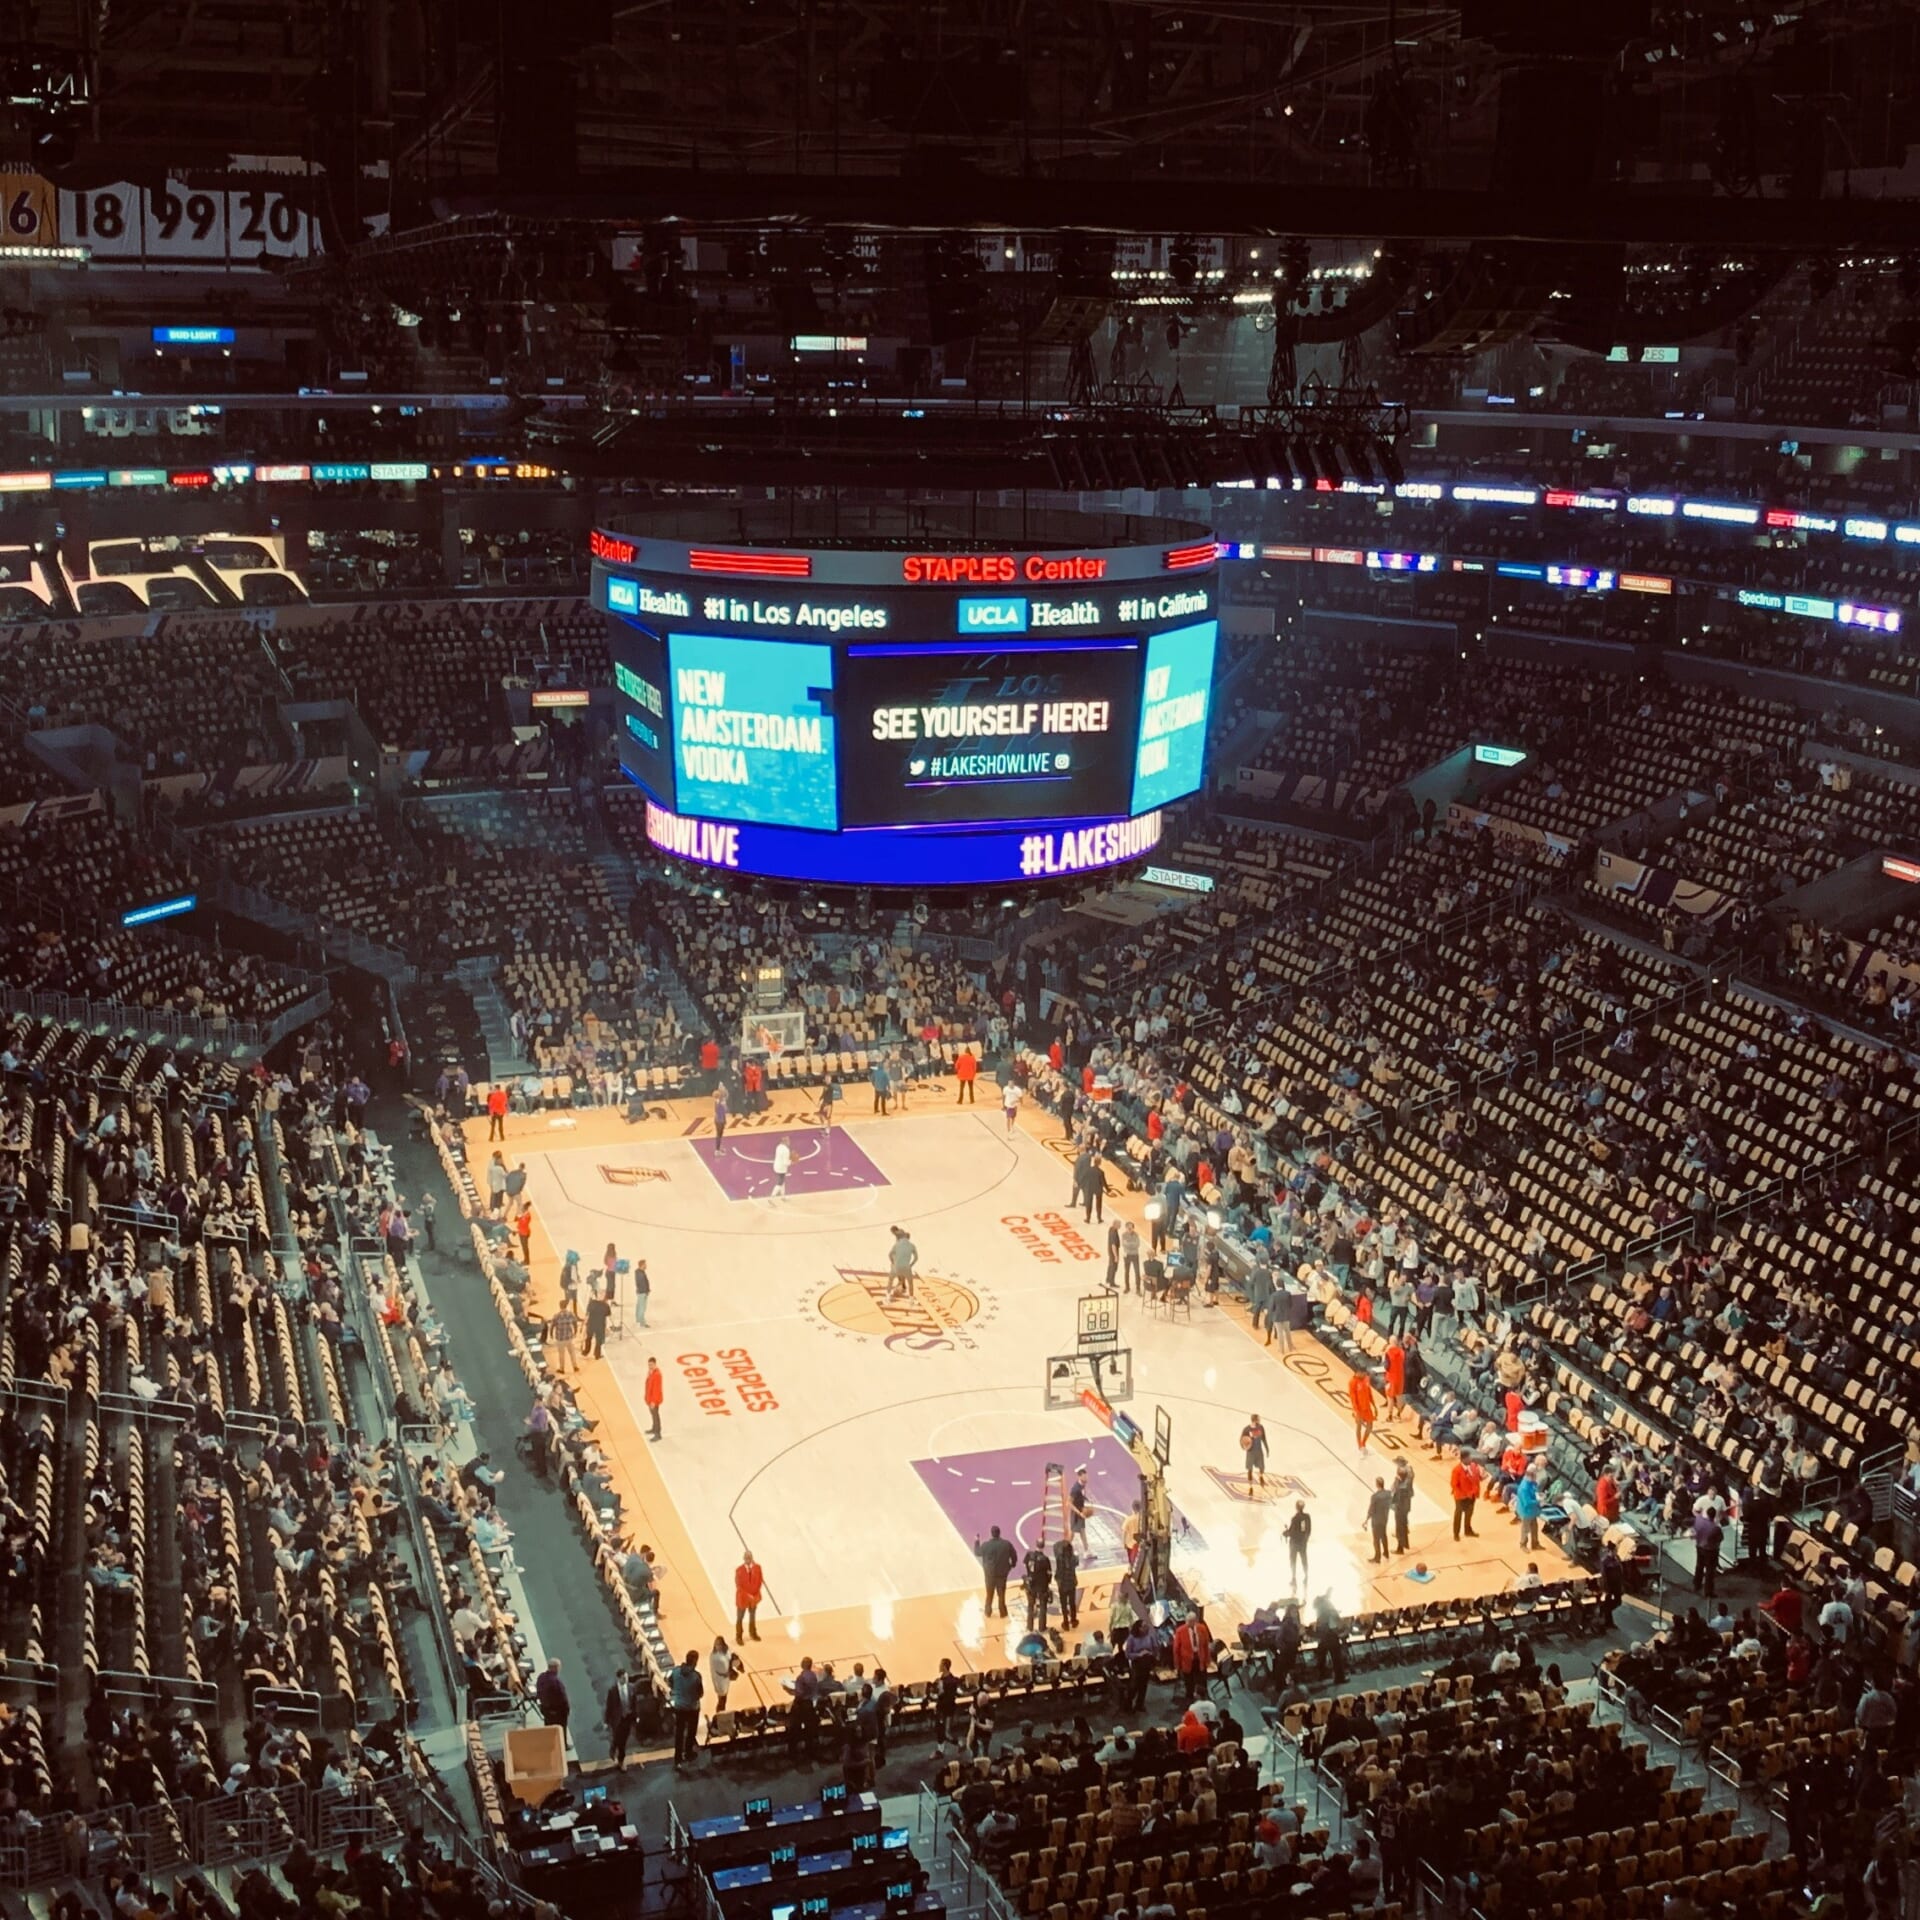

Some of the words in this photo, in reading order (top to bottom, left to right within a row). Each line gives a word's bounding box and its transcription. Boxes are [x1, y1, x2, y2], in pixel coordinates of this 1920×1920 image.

[74, 193, 123, 238] 18
[157, 193, 216, 240] 99
[239, 196, 300, 243] 20
[328, 465, 367, 477] DELTA
[373, 466, 425, 479] STAPLES
[599, 534, 634, 563] Center
[903, 556, 1016, 582] STAPLES
[1024, 556, 1107, 580] Center
[610, 584, 634, 607] UCLA
[638, 587, 690, 618] Health
[703, 597, 726, 621] #1
[729, 599, 749, 622] in
[753, 601, 791, 625] Los
[795, 603, 887, 632] Angeles
[967, 606, 1019, 625] UCLA
[1031, 602, 1101, 626] Health
[1118, 600, 1139, 622] #1
[1141, 598, 1156, 619] in
[1158, 590, 1208, 618] California
[1738, 589, 1782, 608] Spectrum
[677, 668, 726, 707] NEW
[872, 708, 917, 740] SEE
[920, 704, 1039, 738] YOURSELF
[1042, 701, 1109, 733] HERE!
[682, 745, 749, 786] VODKA
[930, 752, 1050, 777] #LAKESHOWLIVE
[1151, 869, 1200, 890] STAPLES
[1000, 1215, 1062, 1264] Center
[1033, 1212, 1101, 1261] STAPLES
[676, 1353, 732, 1416] Center
[716, 1348, 779, 1412] STAPLES
